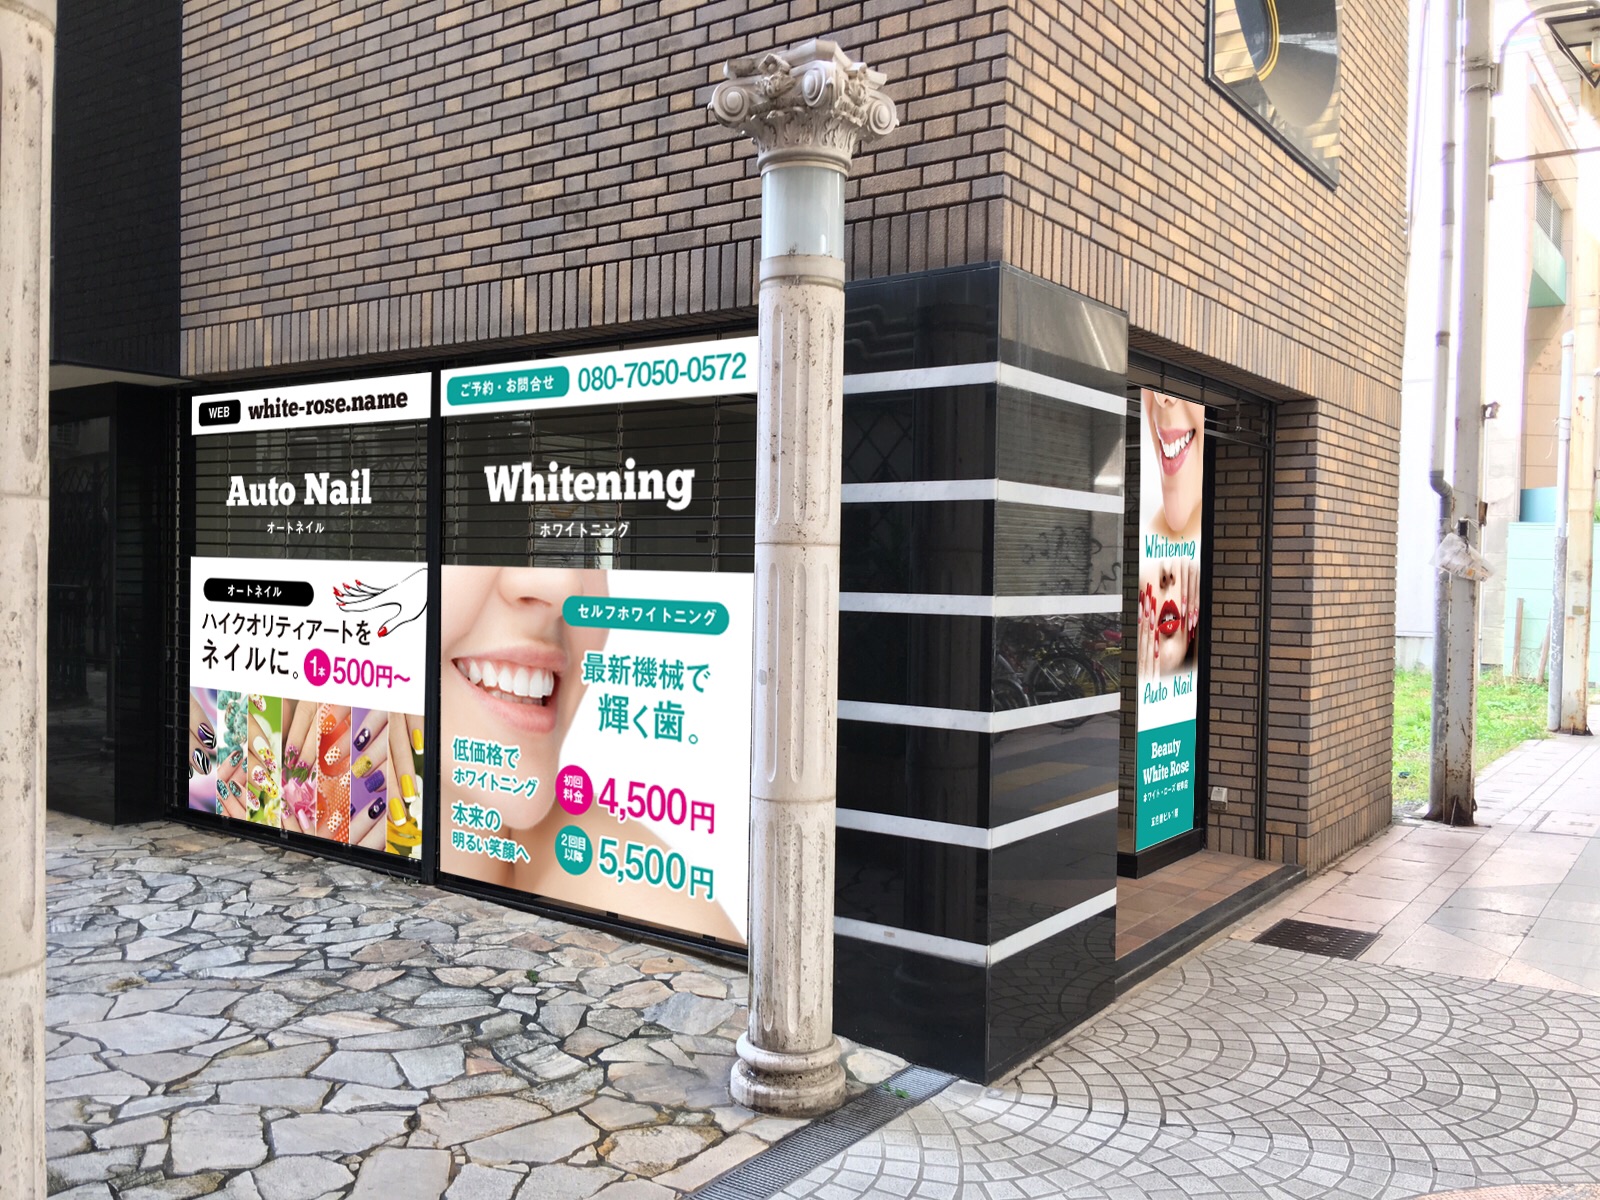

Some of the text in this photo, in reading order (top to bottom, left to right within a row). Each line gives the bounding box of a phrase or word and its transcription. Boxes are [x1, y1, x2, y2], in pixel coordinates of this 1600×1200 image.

[578, 352, 747, 392] 080-7050-0572
[460, 375, 554, 398] ご予約・お問合せ
[209, 407, 230, 419] WEB
[249, 392, 408, 420] white-rose.name
[226, 468, 372, 507] Auto Nail
[484, 457, 695, 511] Whitening
[267, 521, 325, 534] オートネイル
[540, 522, 630, 538] ホワイトニング
[1145, 534, 1196, 560] Whitening
[227, 585, 282, 598] オートネイル
[202, 612, 371, 645] ハイクオリティアートを
[578, 603, 717, 626] セルフホワイトニング
[202, 638, 299, 679] ネイルに。
[583, 653, 711, 693] 最新機械で
[1143, 671, 1193, 704] Auto Nail
[598, 693, 698, 744] 輝く歯。
[453, 738, 520, 769] 低価格で
[1151, 739, 1181, 759] Beauty
[453, 769, 538, 797] ホワイトニング
[563, 774, 583, 788] 初回
[1142, 760, 1190, 785] White Rose
[563, 788, 584, 804] 料金
[600, 778, 715, 834] 4,500円
[452, 803, 501, 831] 本来の
[452, 832, 529, 862] 明るい笑顔へ
[561, 834, 587, 850] 2回目
[599, 841, 714, 900] 5,500円
